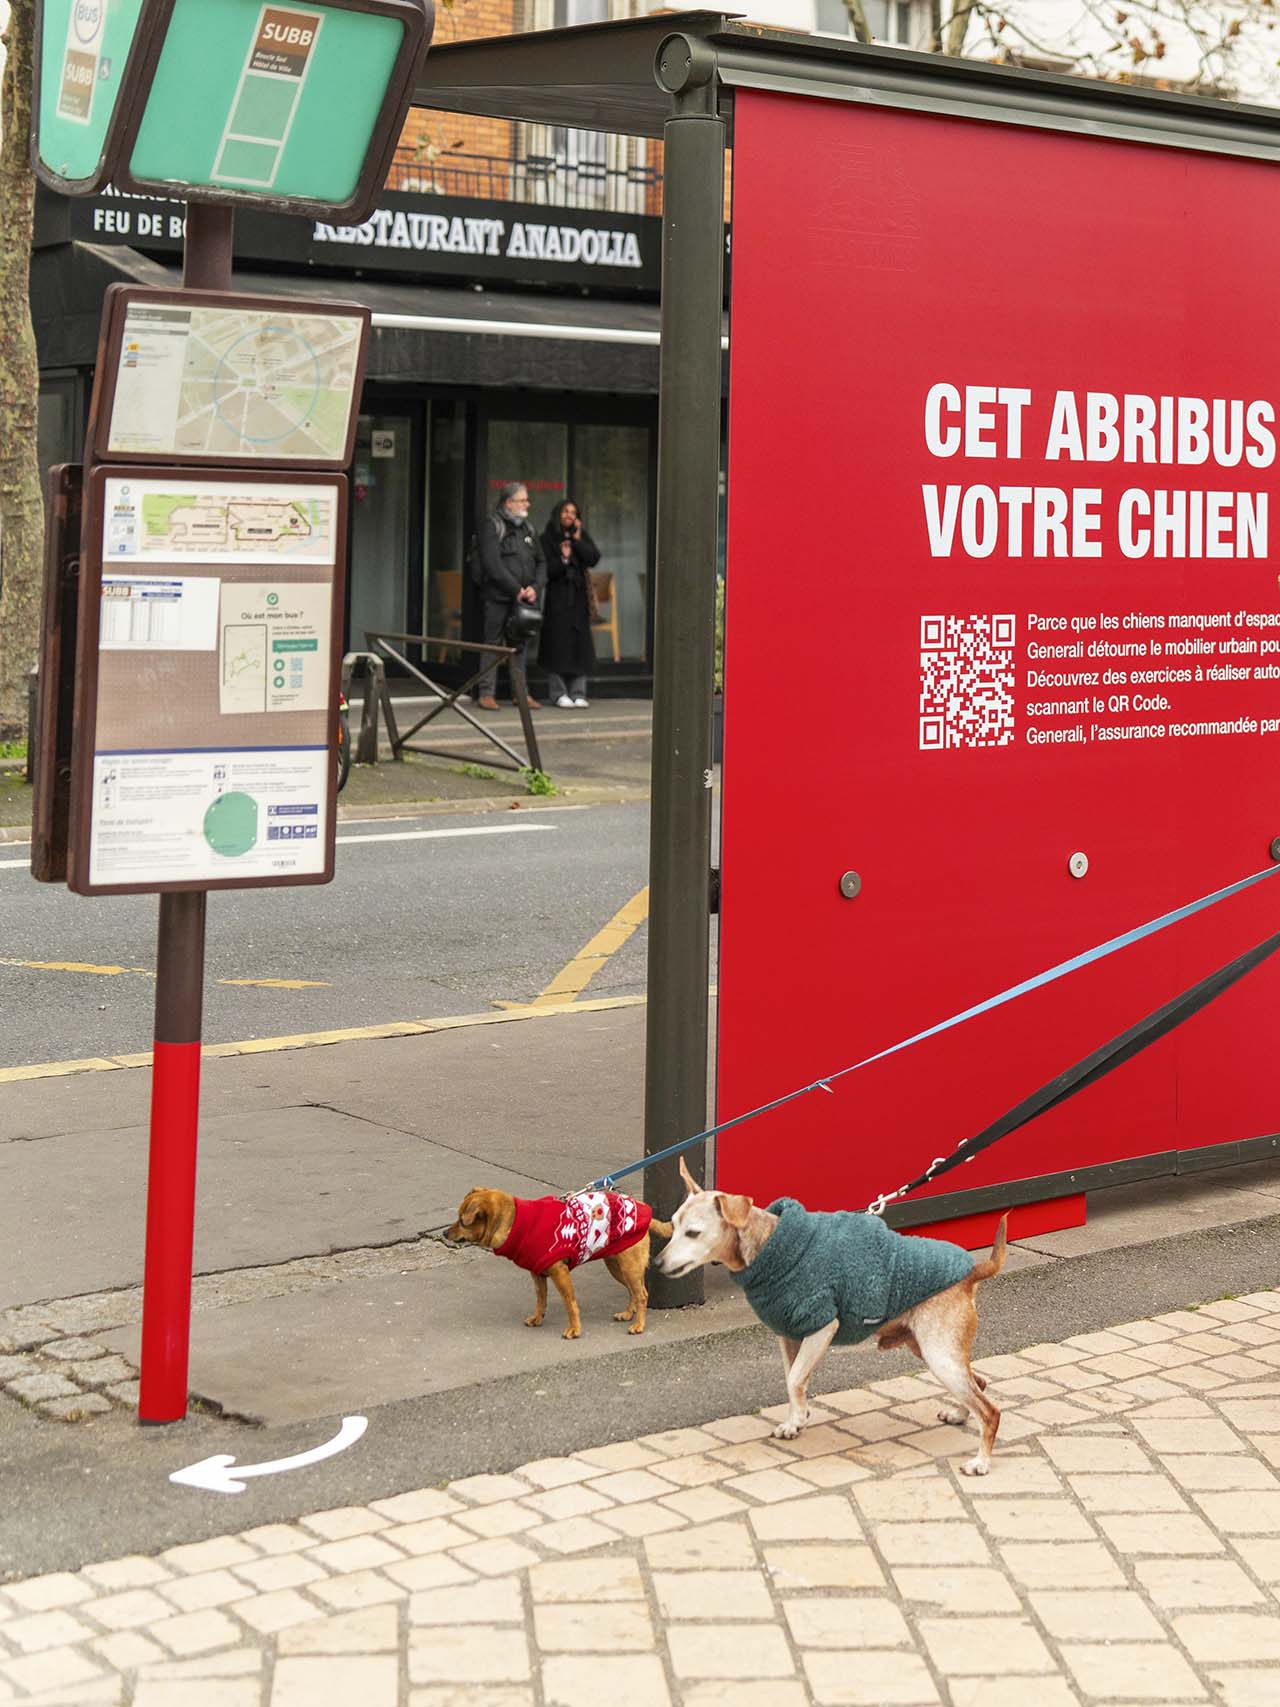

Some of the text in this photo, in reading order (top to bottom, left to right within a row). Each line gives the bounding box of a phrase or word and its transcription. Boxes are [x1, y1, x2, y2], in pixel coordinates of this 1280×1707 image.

[262, 23, 313, 46] SUBB
[65, 64, 93, 86] SUBB
[94, 208, 187, 239] FEU DE B
[506, 223, 643, 268] ANADOLIA
[925, 383, 1031, 459] CET
[1045, 390, 1276, 468] ABRIBUS
[922, 484, 1102, 558] VOTRE
[1118, 488, 1268, 559] CHIEN
[1028, 614, 1067, 630] Parce
[1071, 617, 1096, 633] que
[1100, 613, 1119, 629] les
[1123, 613, 1165, 628] chiens
[1169, 612, 1231, 631] manquent
[1027, 641, 1083, 659] Generali
[1088, 640, 1147, 657] détourne
[1151, 640, 1162, 655] le
[1165, 638, 1216, 655] mobilier
[1219, 637, 1257, 654] urbain
[1028, 670, 1099, 687] Découvrez
[1103, 669, 1127, 684] des
[1130, 666, 1192, 683] exercices
[1195, 665, 1203, 681] à
[1206, 664, 1251, 680] réaliser
[1027, 694, 1171, 716] scannant le QR Code.
[1026, 725, 1086, 744] Generali,
[1169, 717, 1257, 736] recommandée
[1261, 719, 1280, 735] par
